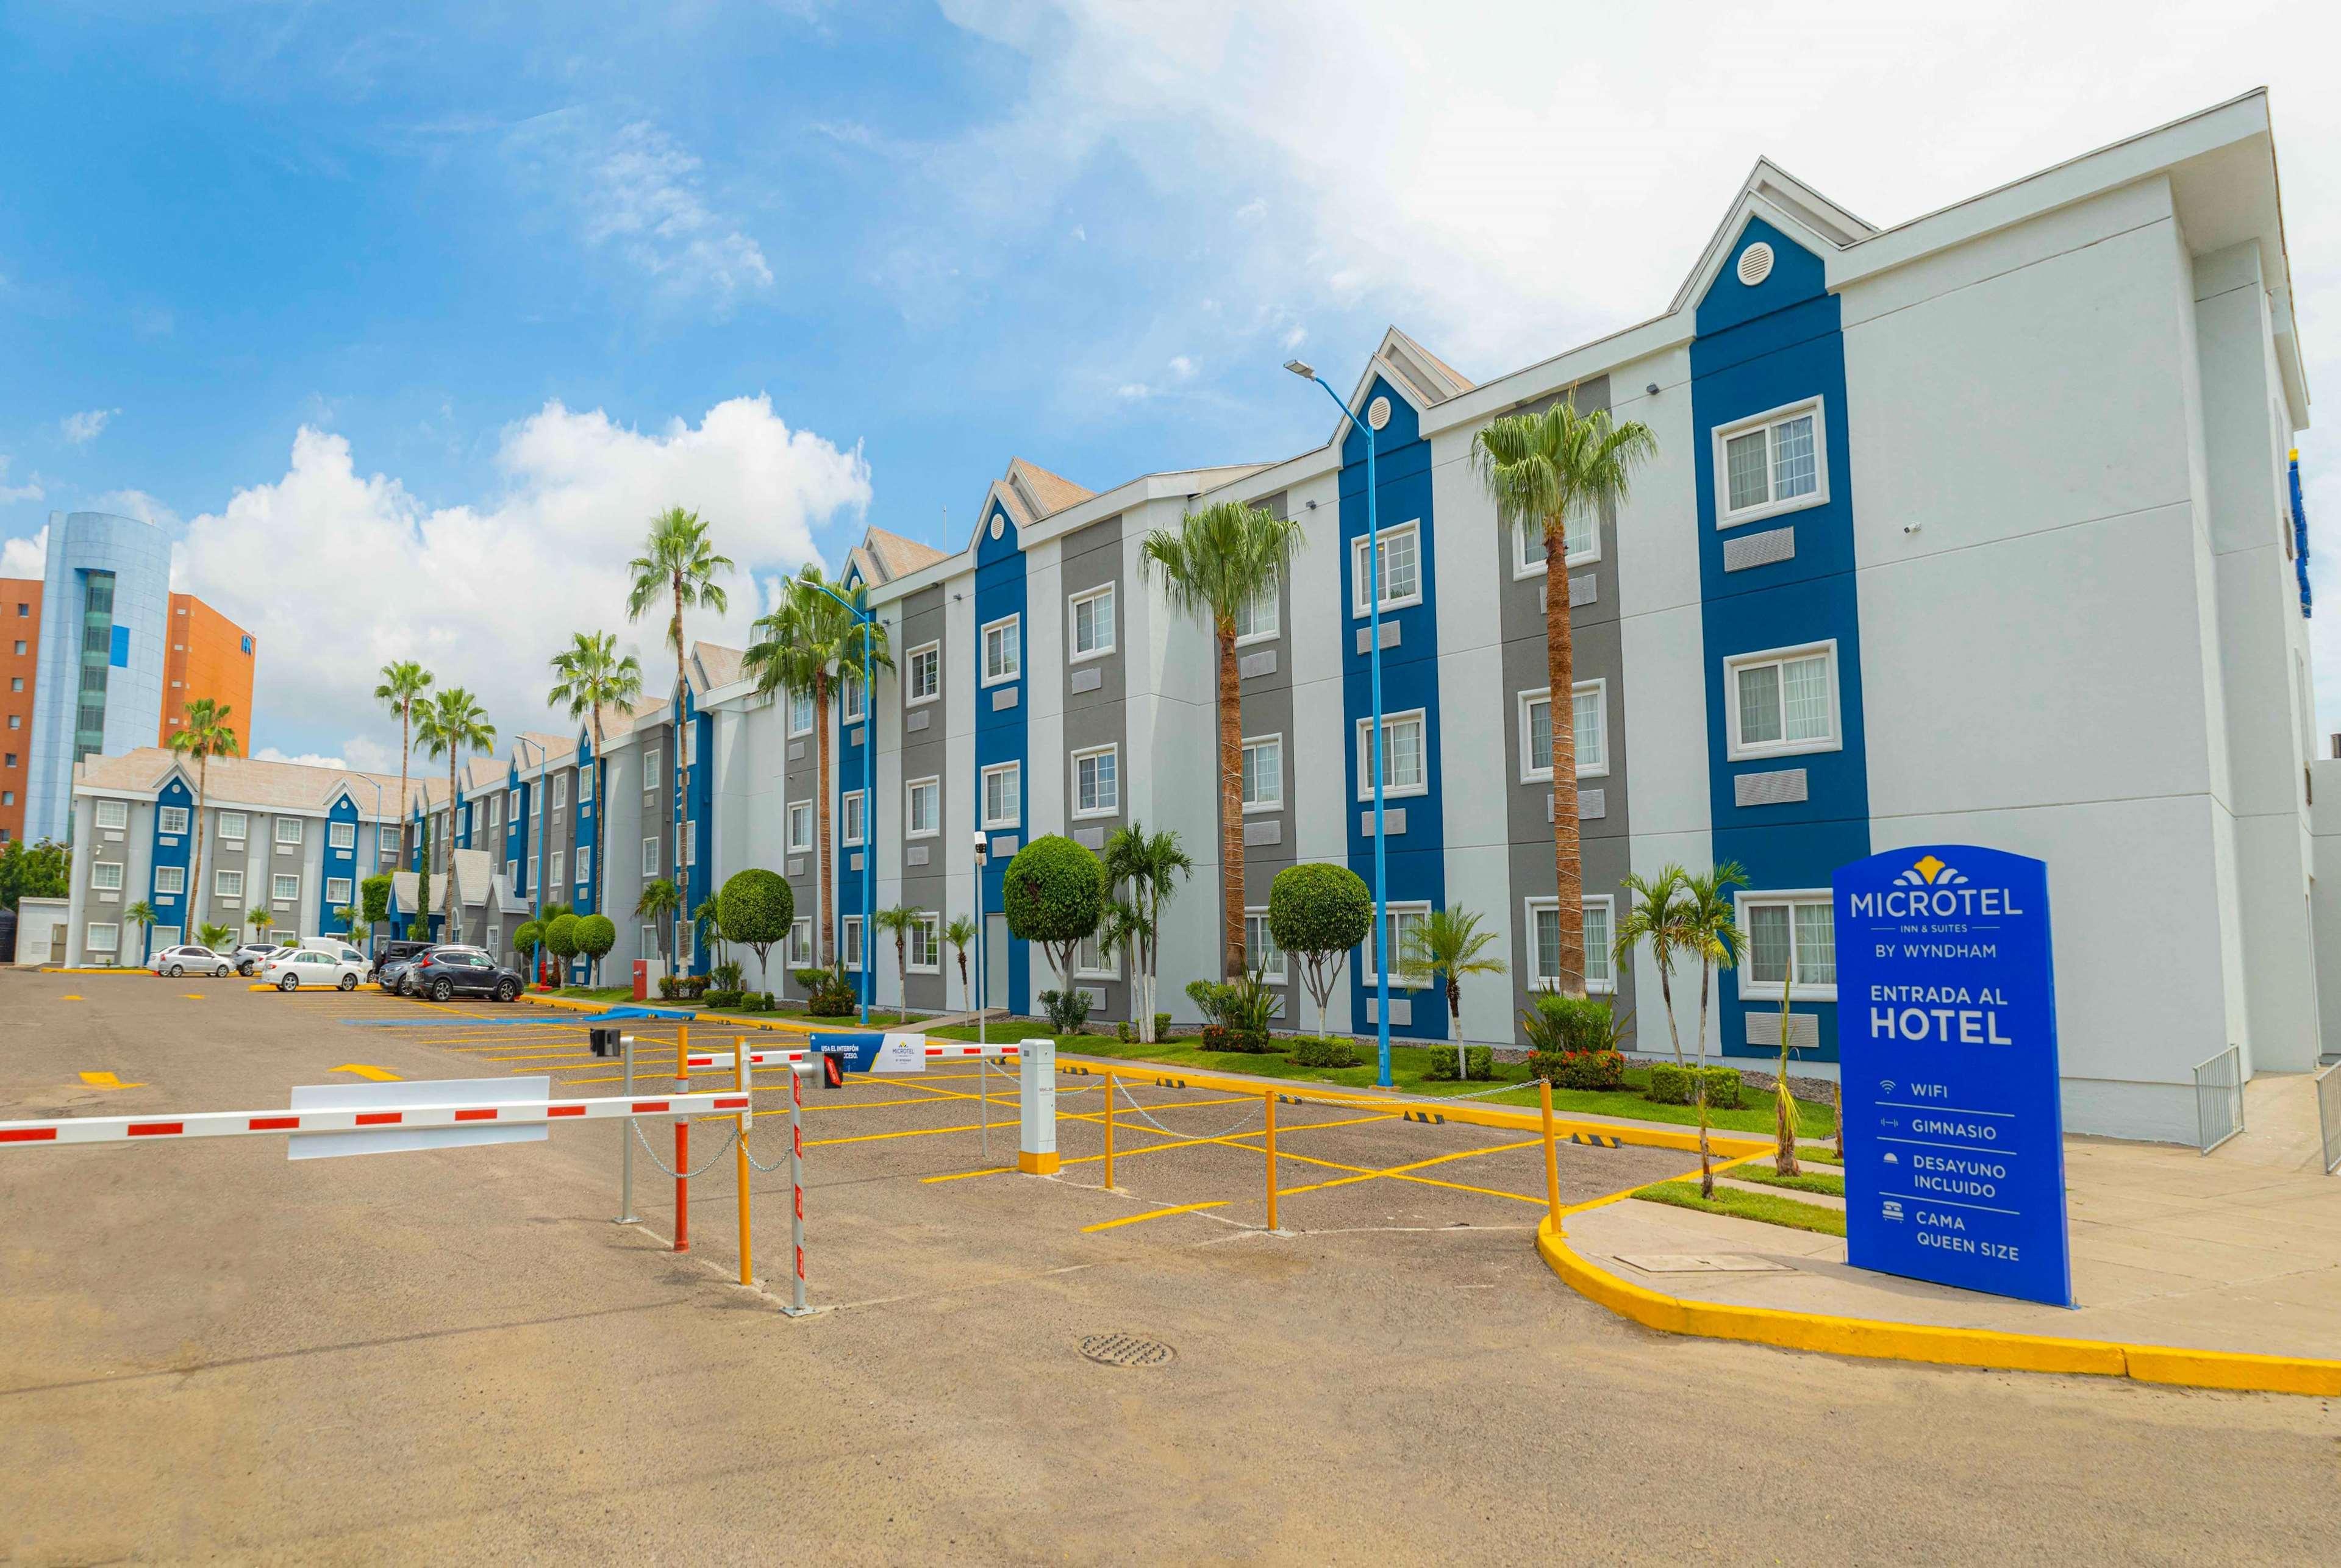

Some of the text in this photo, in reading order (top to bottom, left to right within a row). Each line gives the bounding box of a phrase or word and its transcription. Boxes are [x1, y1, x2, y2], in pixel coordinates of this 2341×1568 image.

[1851, 888, 2023, 918] MICROTEL
[1931, 924, 1968, 933] SUITES
[1876, 944, 1996, 958] BY WYNDHAM
[1871, 985, 2008, 1005] ENTRADA AL
[1870, 1007, 2012, 1046] HOTEL
[1911, 1083, 1948, 1098] WIFI
[1912, 1119, 1996, 1139] GIMNASIO
[1914, 1155, 2006, 1178] DESAYUNO
[1915, 1175, 1995, 1197] INCLUIDO
[1916, 1211, 1965, 1231] CAMA
[1917, 1232, 2020, 1261] QUEEN SIZE
